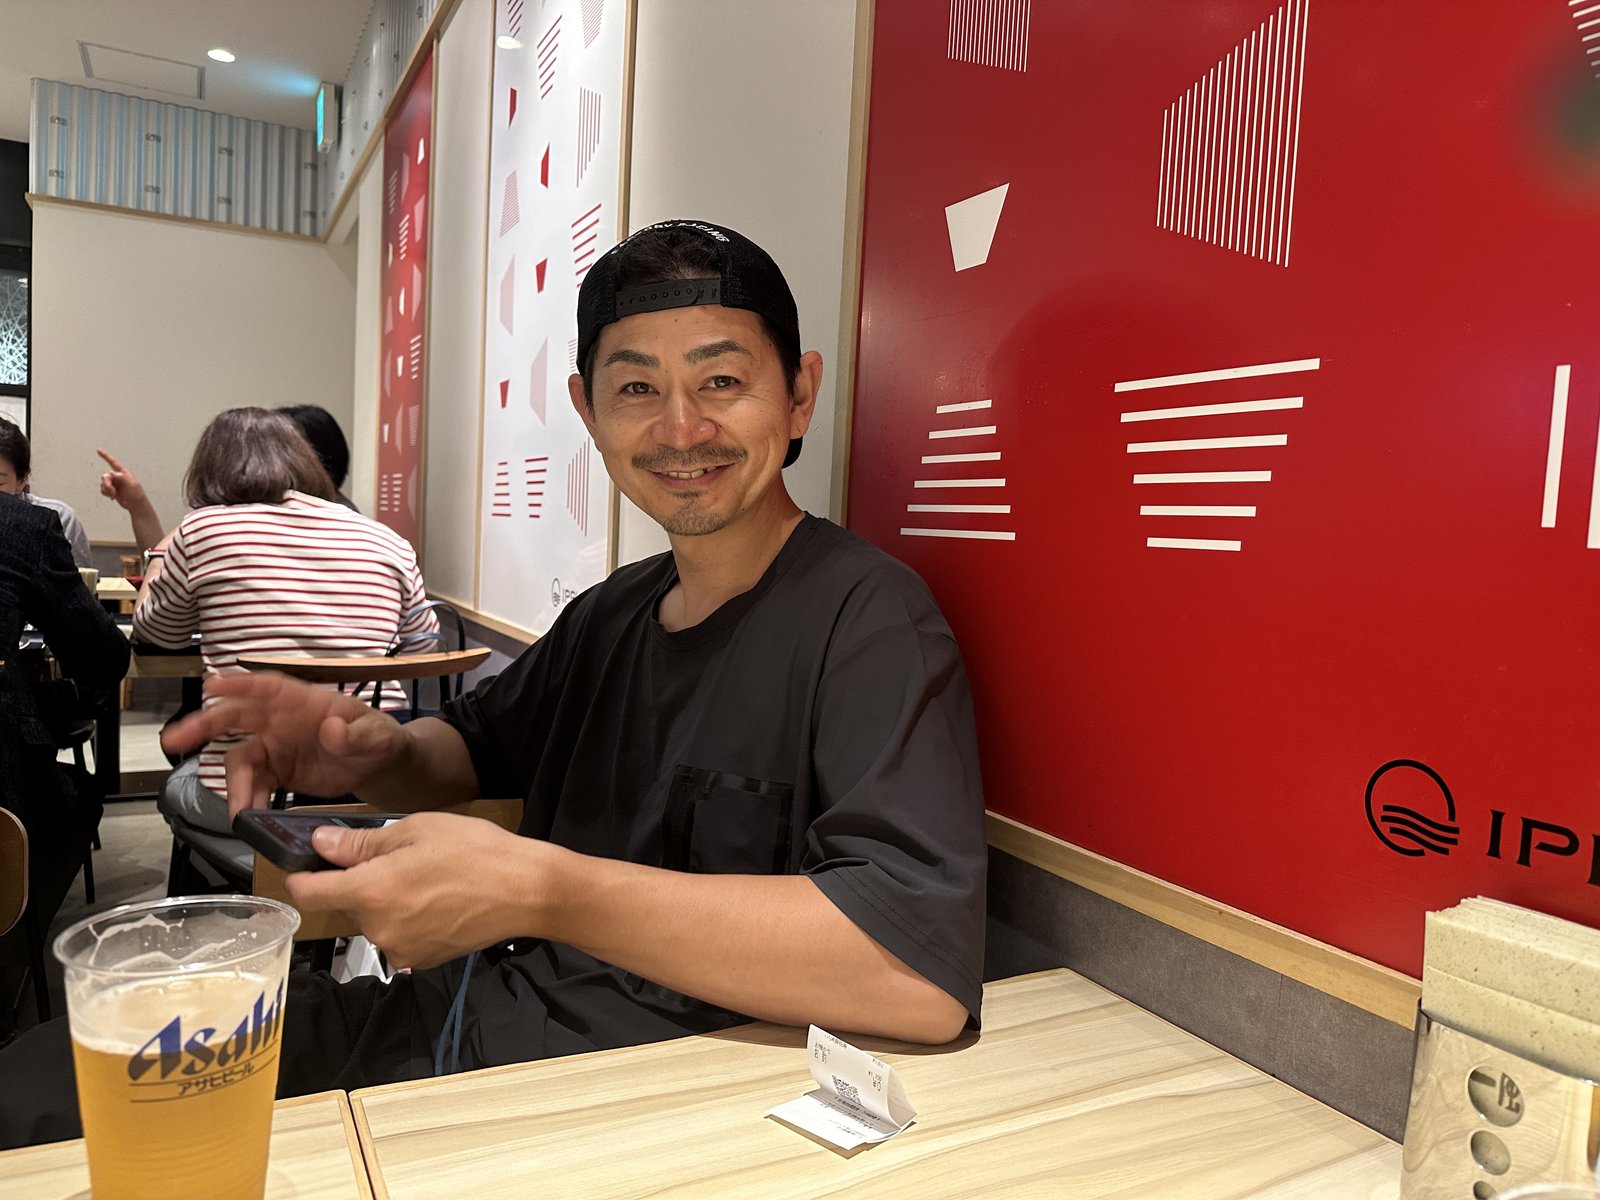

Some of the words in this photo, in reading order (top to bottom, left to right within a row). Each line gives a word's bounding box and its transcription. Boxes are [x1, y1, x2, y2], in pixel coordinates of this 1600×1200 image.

[127, 976, 284, 1081] Asahi
[178, 1062, 255, 1096] アサヒビール
